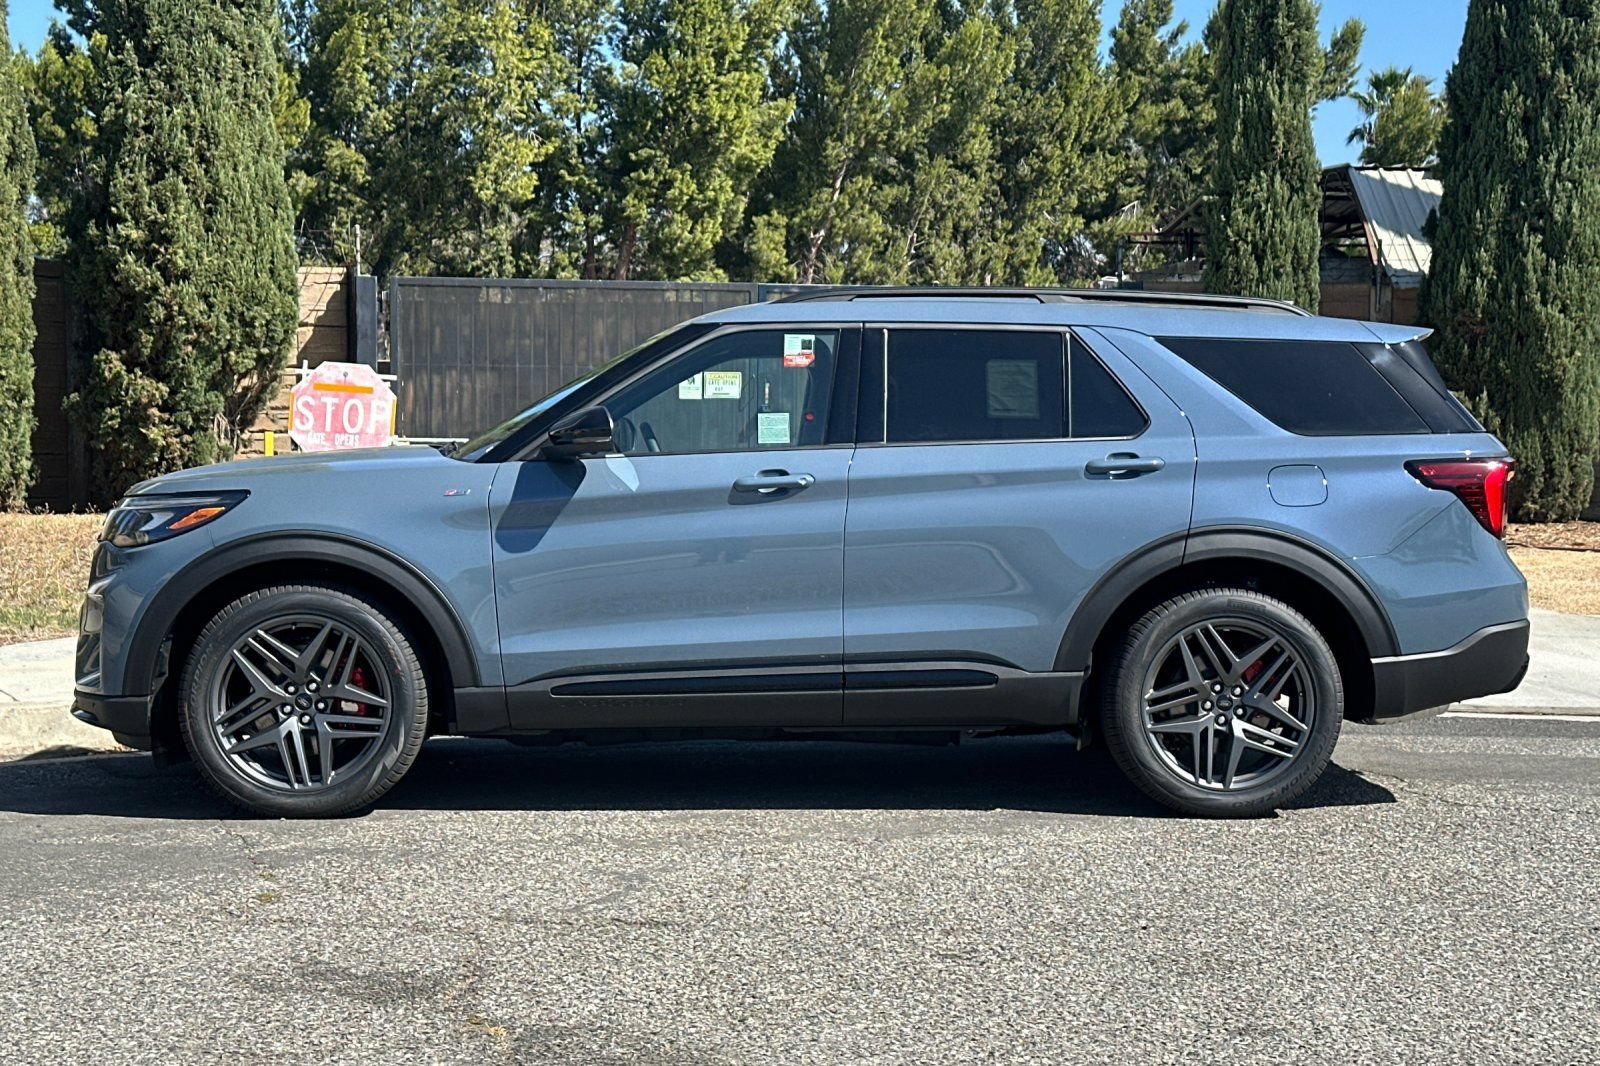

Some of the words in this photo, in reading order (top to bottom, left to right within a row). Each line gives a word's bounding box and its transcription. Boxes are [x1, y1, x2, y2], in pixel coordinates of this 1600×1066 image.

[295, 395, 388, 434] STOP
[309, 432, 325, 444] GATE
[334, 433, 360, 446] OPENS
